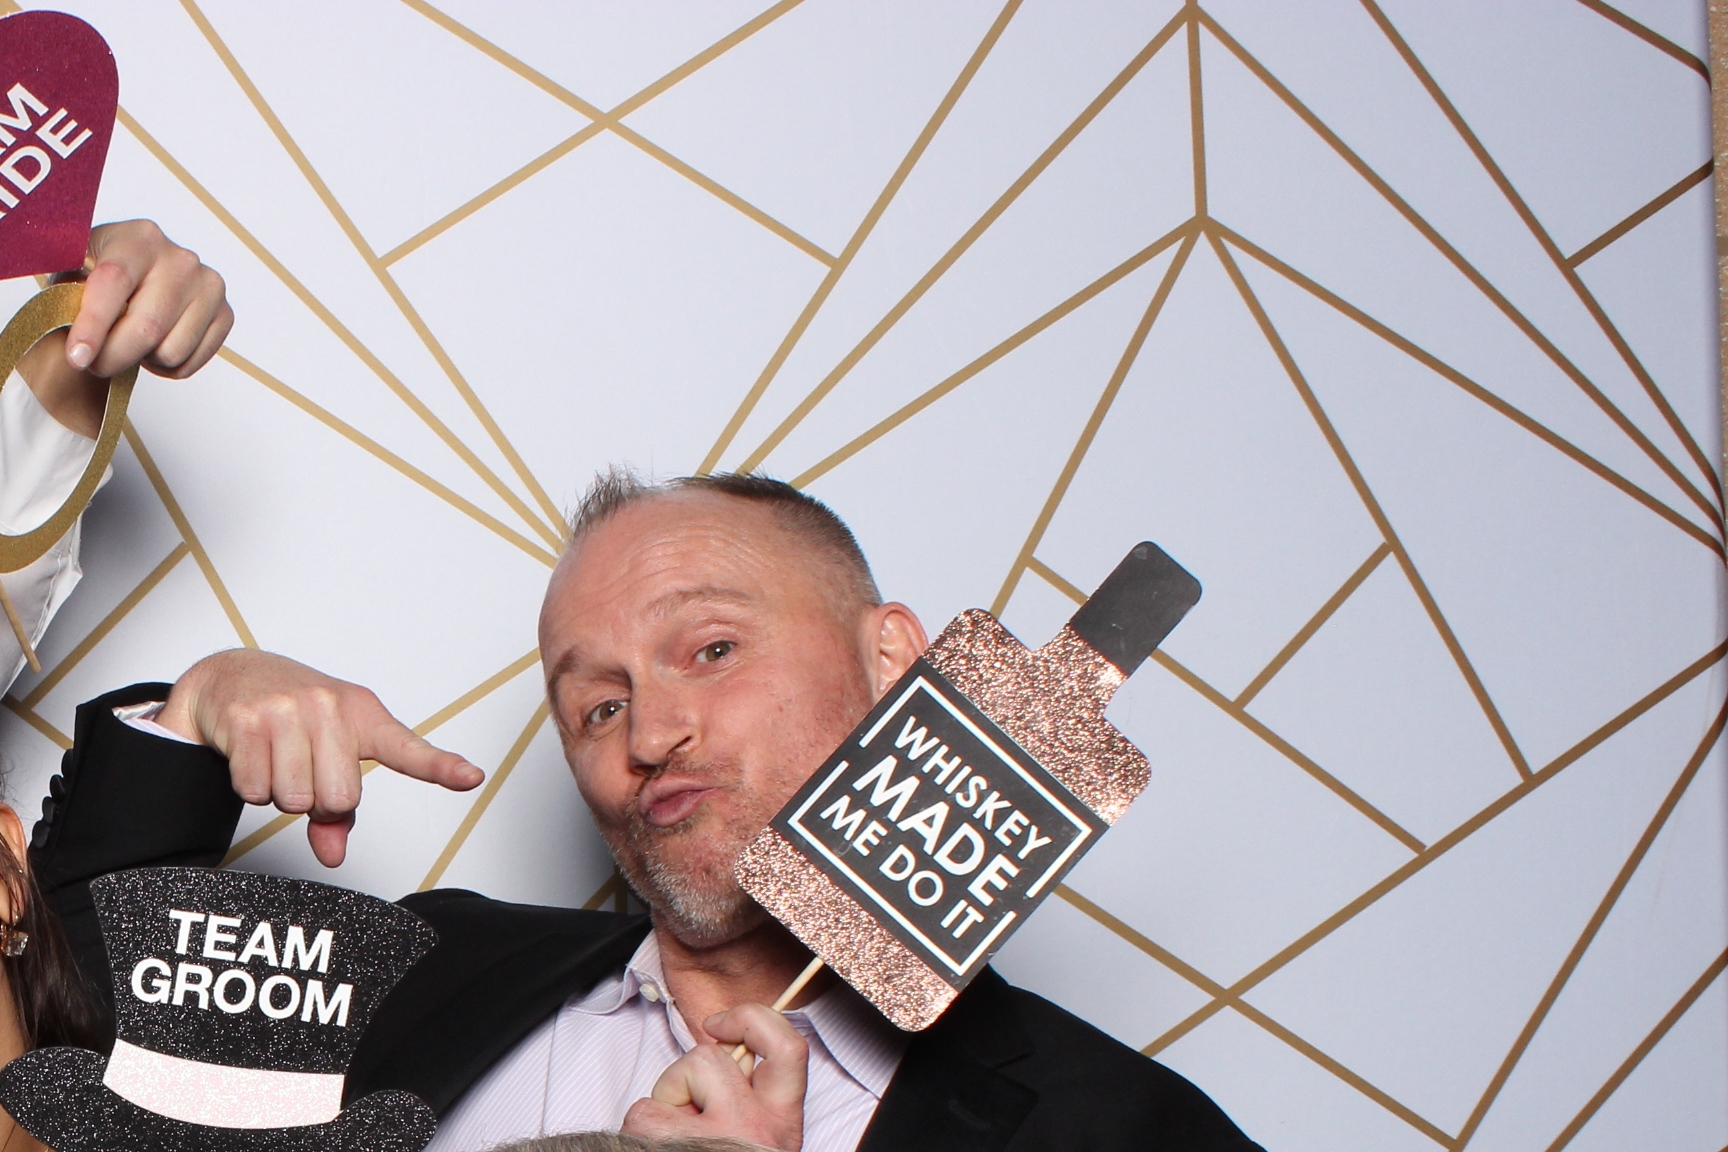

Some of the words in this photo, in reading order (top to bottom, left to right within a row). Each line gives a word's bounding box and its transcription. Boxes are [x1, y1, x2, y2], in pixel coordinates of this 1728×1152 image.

[852, 755, 1020, 906] MADE
[894, 715, 1053, 860] WHISKEY
[819, 795, 888, 857] ME
[879, 844, 944, 907] DO
[940, 899, 984, 939] IT
[131, 958, 354, 1028] GROOM
[169, 908, 334, 973] TEAM
